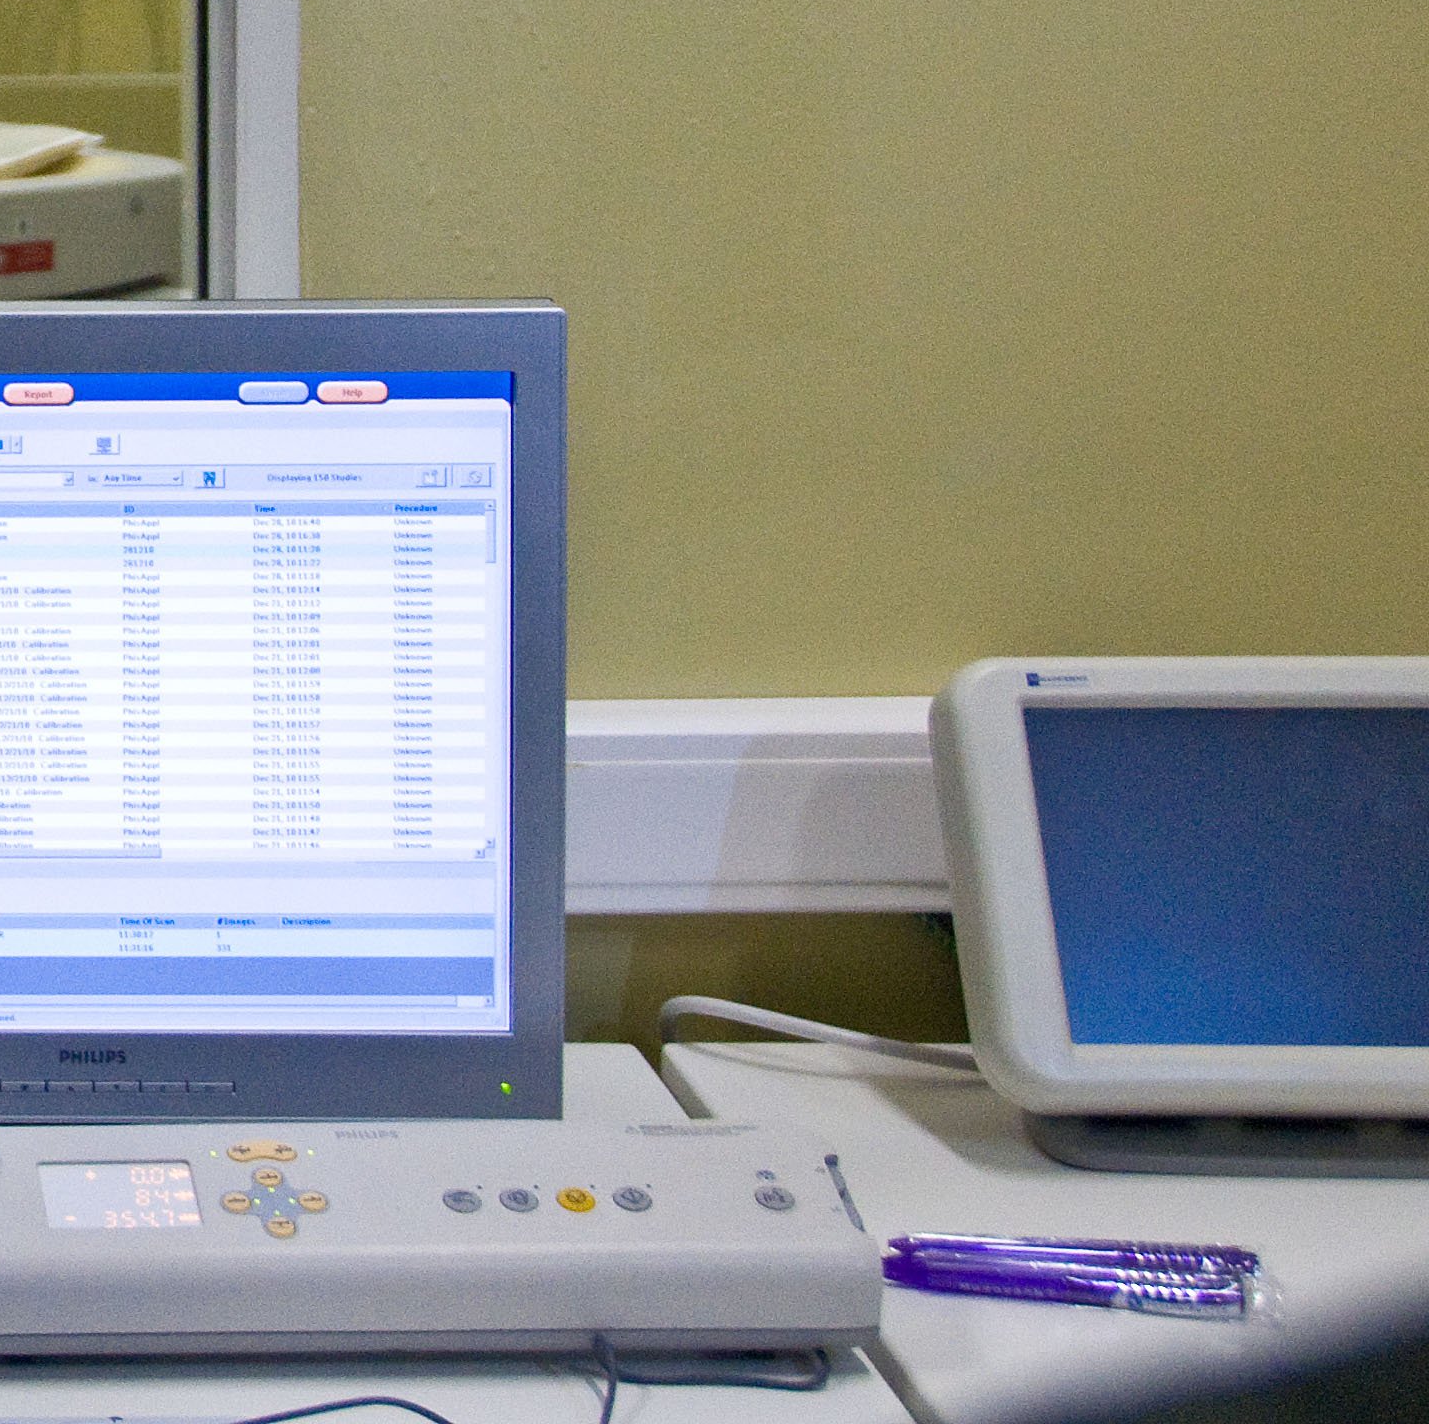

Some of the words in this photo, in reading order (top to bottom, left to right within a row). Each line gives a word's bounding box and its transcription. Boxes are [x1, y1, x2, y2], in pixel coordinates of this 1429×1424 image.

[23, 389, 53, 401] Report
[342, 388, 363, 398] Help
[58, 1049, 127, 1065] PHILIPS
